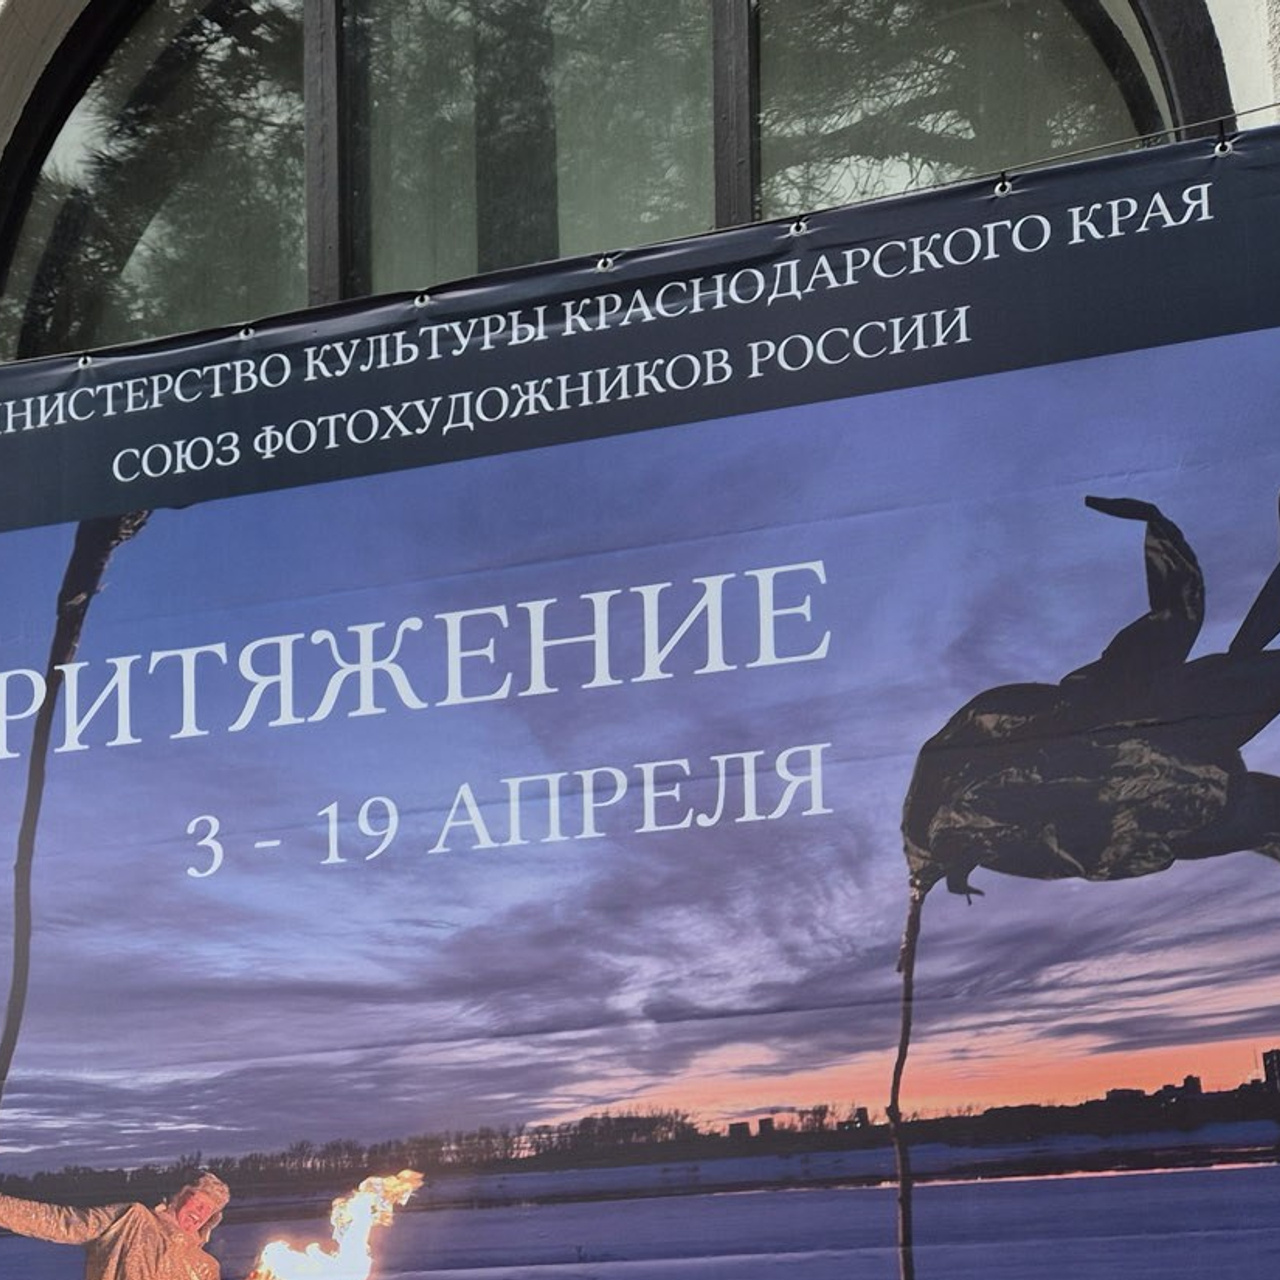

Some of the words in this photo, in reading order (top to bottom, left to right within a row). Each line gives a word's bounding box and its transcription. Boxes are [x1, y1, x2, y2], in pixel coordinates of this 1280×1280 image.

[303, 305, 548, 384] КУЛЬТУРЫ
[562, 214, 1051, 339] КРАСНОДАРСКОГО
[1067, 183, 1214, 245] КРАЯ
[112, 432, 241, 483] СОЮЗ
[253, 348, 733, 461] ФОТОХУДОЖНИКОВ
[748, 305, 972, 379] РОССИИ
[187, 814, 224, 878] 3
[320, 795, 399, 866] 19
[429, 742, 832, 854] АПРЕЛЯ
